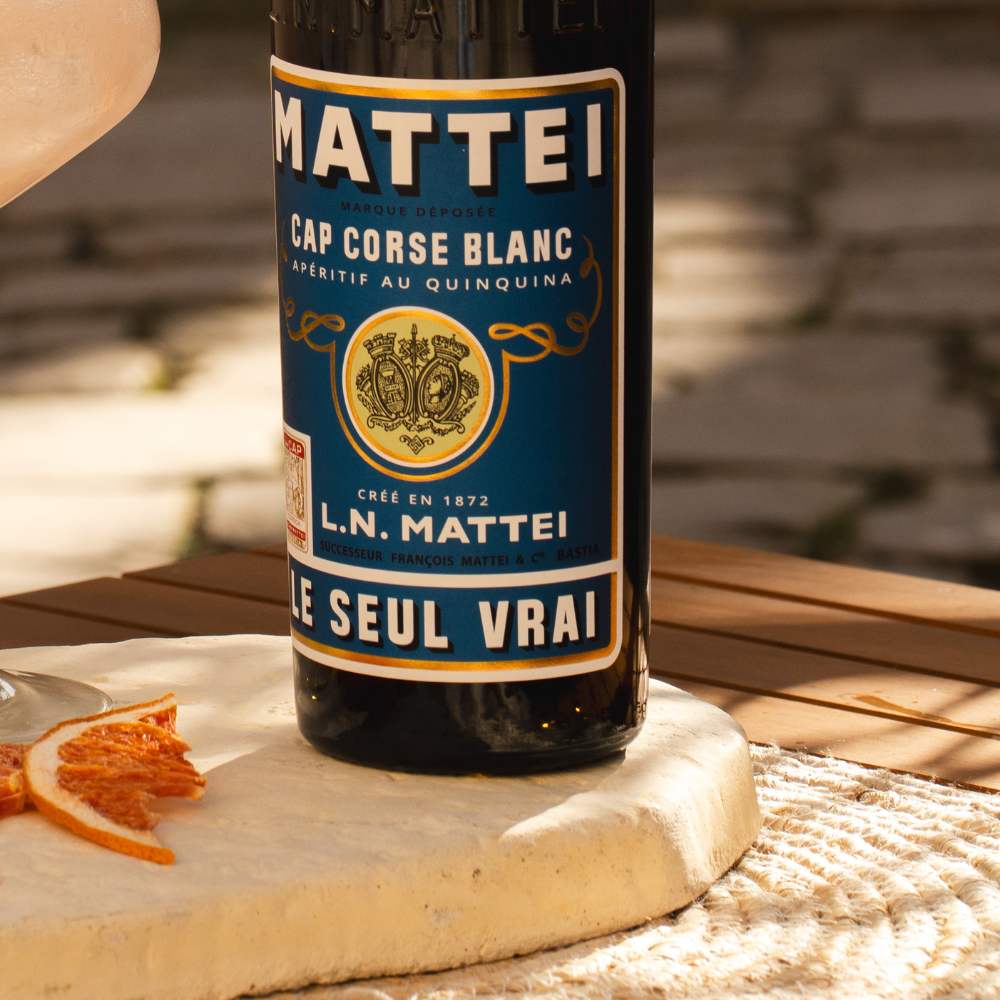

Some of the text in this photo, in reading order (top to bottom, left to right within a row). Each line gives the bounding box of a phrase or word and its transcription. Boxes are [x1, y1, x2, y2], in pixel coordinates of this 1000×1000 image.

[274, 89, 605, 193] MATTEI
[340, 201, 496, 218] MARQUE DÉPOSÉE
[291, 212, 573, 266] CAP CORSE BLANC
[292, 259, 572, 293] APÉRITIF AU QUINQUINA
[358, 489, 489, 507] CRÉÉ EN 1872
[321, 502, 389, 540] L.N.
[401, 510, 567, 544] MATTEI
[319, 539, 383, 562] SUCCESSEUR
[390, 552, 454, 568] FRANÇOIS
[461, 554, 509, 567] MATTEI
[515, 553, 525, 565] &
[557, 542, 600, 562] BASTIA
[291, 569, 597, 651] LE SEUL VRAI
